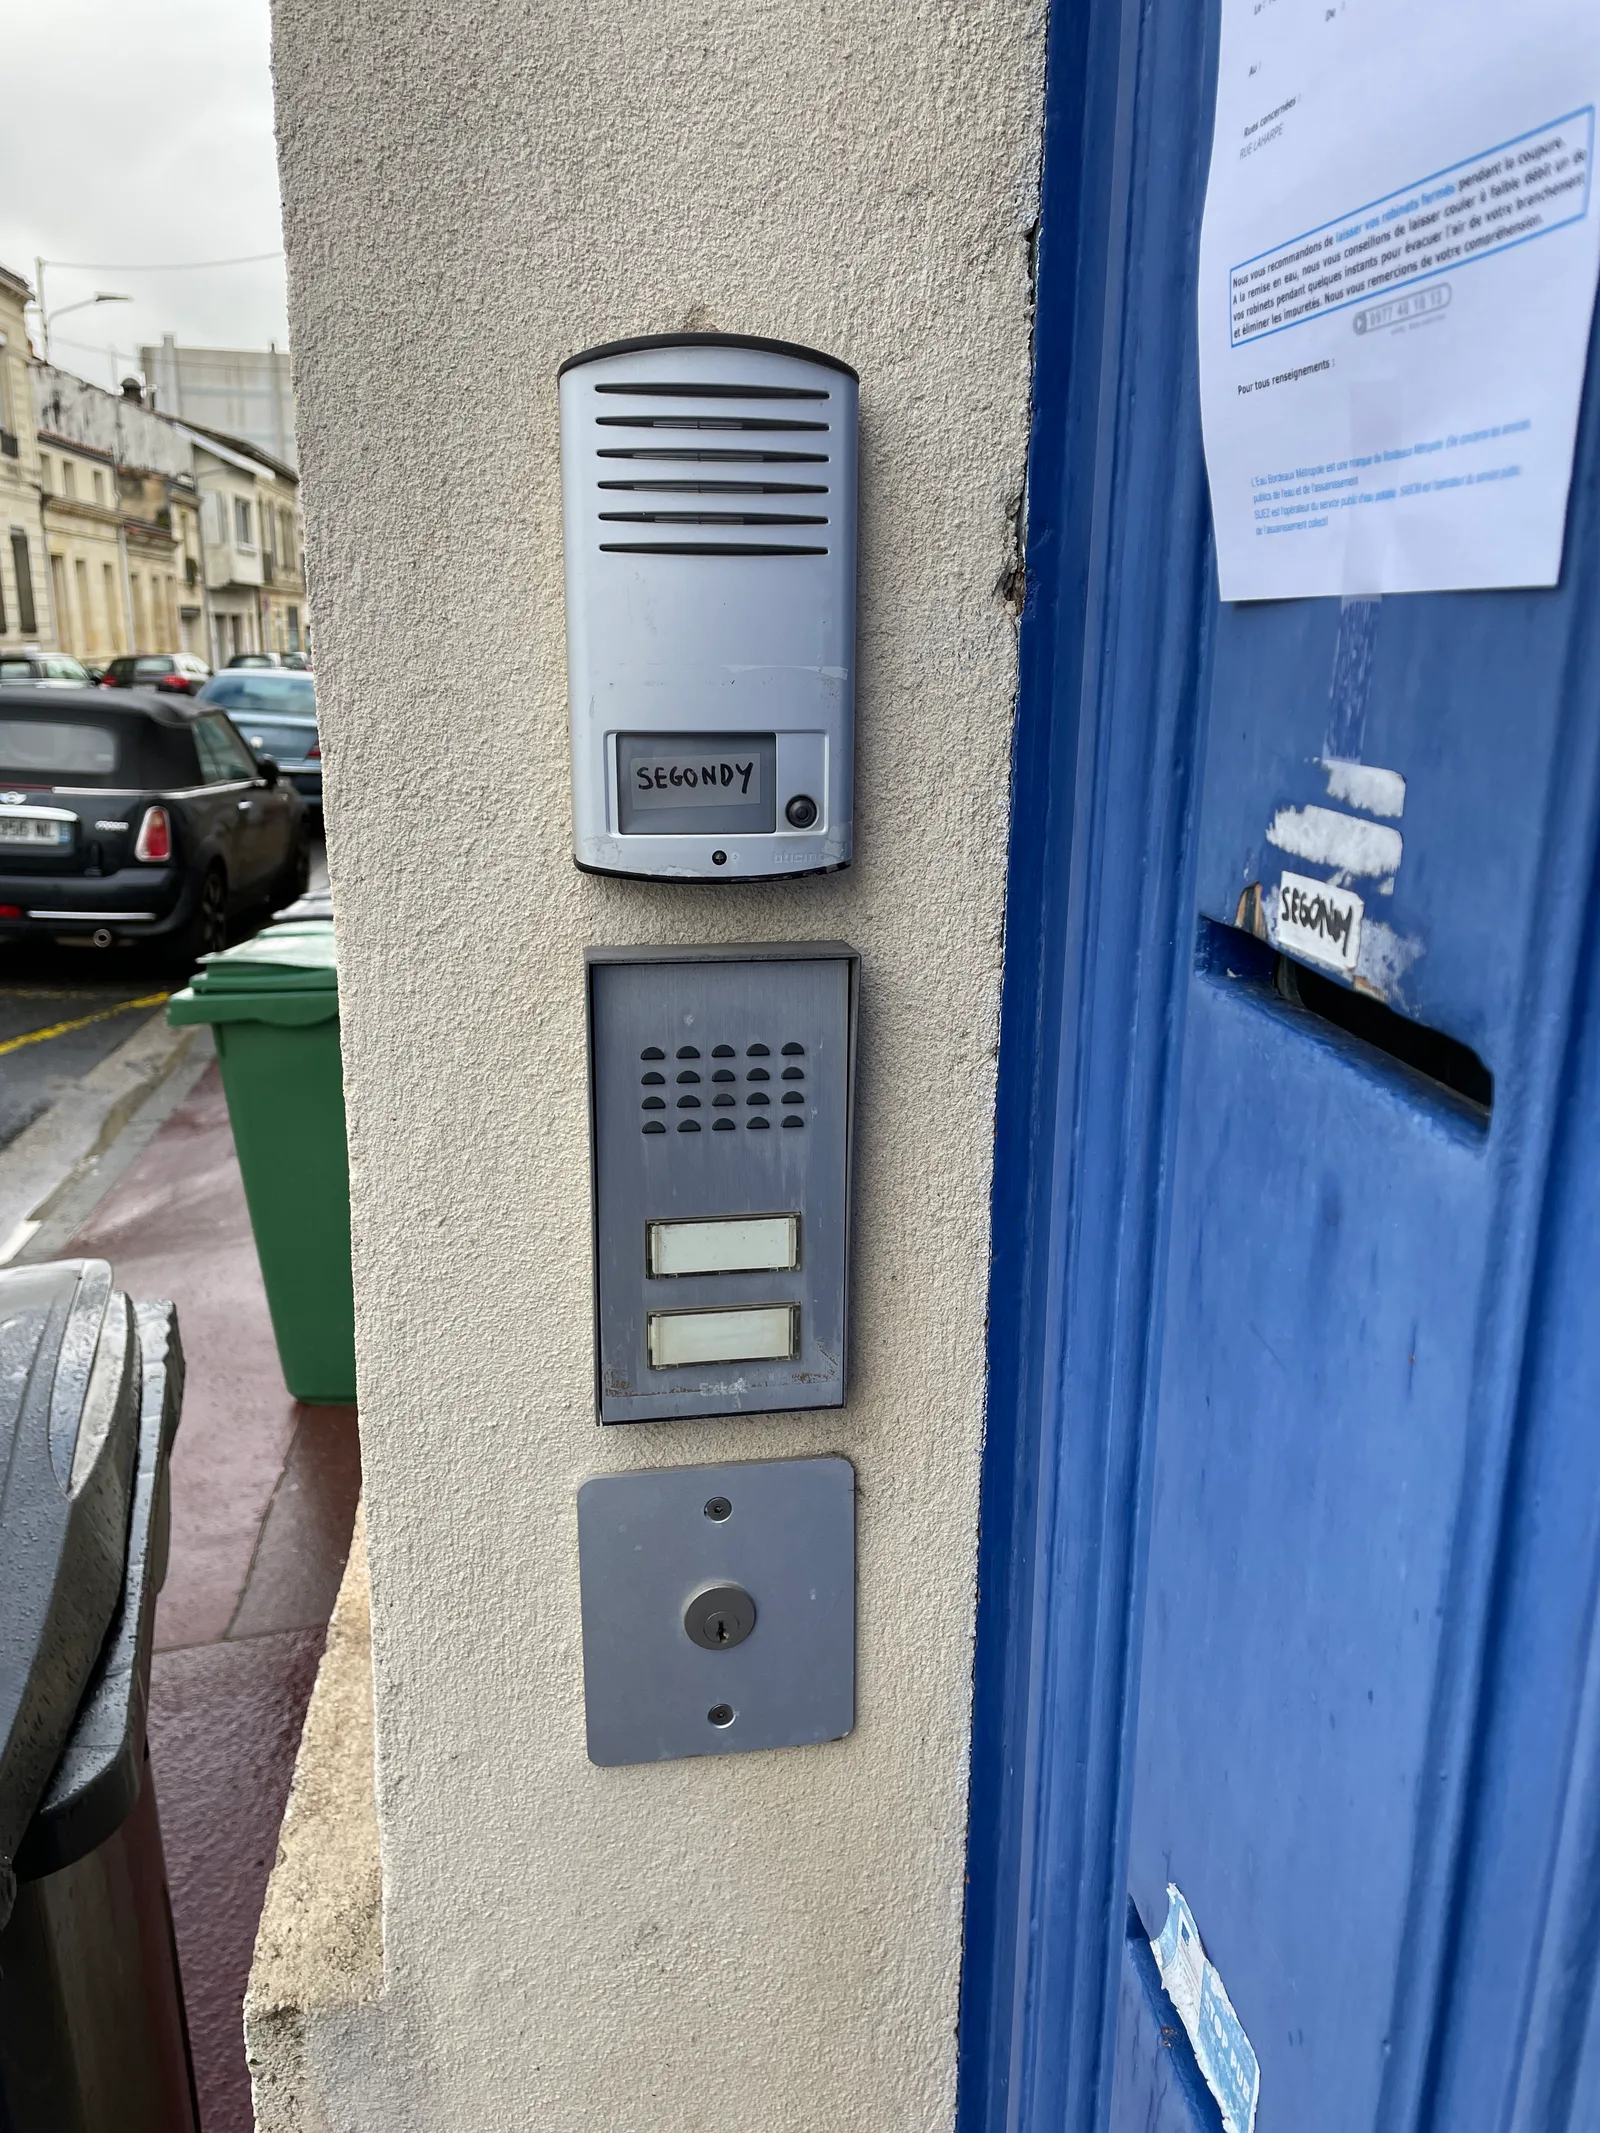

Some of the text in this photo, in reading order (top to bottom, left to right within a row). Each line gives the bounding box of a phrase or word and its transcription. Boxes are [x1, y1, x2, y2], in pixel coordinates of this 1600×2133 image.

[1243, 121, 1259, 138] Rues
[1260, 96, 1297, 127] concernées
[1239, 122, 1284, 160] RUE LAHARPE
[1233, 274, 1249, 288] Nous
[1250, 266, 1266, 281] vous
[1267, 241, 1322, 273] recommandons
[1324, 235, 1334, 247] de
[1335, 224, 1362, 243] laisser
[1364, 216, 1380, 230] vos
[1233, 310, 1244, 322] vos
[1246, 298, 1274, 316] robinets
[1276, 284, 1306, 307] pendant
[1308, 270, 1342, 293] quelques
[1344, 256, 1379, 277] instants
[1380, 246, 1402, 268] pour
[1405, 231, 1442, 254] évacuer
[1468, 214, 1482, 229] de
[1484, 203, 1513, 222] votre
[1239, 291, 1246, 302] la
[1247, 282, 1271, 299] remise
[1272, 277, 1282, 289] en
[1284, 271, 1300, 284] eau,
[1302, 262, 1320, 276] nous
[1323, 252, 1341, 267] vous
[1344, 230, 1391, 258] conseillons
[1394, 224, 1406, 238] de
[1408, 211, 1440, 232] laisser
[1444, 196, 1475, 218] couler
[1233, 328, 1241, 339] et
[1242, 317, 1270, 335] éliminer
[1271, 312, 1282, 325] les
[1283, 297, 1323, 320] impuretés.
[1324, 289, 1344, 305] Nous
[1345, 281, 1366, 296] vous
[1367, 261, 1418, 288] remercions
[1421, 254, 1433, 268] de
[1435, 244, 1461, 263] votre
[1237, 384, 1254, 396] Pour
[1254, 378, 1271, 391] tous
[1272, 359, 1330, 384] renseignements
[1267, 471, 1295, 484] Bordeaux
[1295, 465, 1325, 479] Métropole
[1326, 462, 1337, 473] est
[1336, 460, 1349, 471] une
[1253, 492, 1272, 505] publics
[1272, 490, 1281, 500] de
[1281, 488, 1295, 499] l'eau
[1295, 486, 1302, 496] et
[1302, 484, 1311, 494] de
[1254, 508, 1271, 520] SUEZ
[1271, 507, 1280, 518] est
[1311, 500, 1319, 511] du
[1319, 498, 1340, 510] service
[1256, 526, 1264, 536] de
[636, 762, 754, 795] SEGONDY
[1204, 1990, 1251, 2103] STOP PUB
